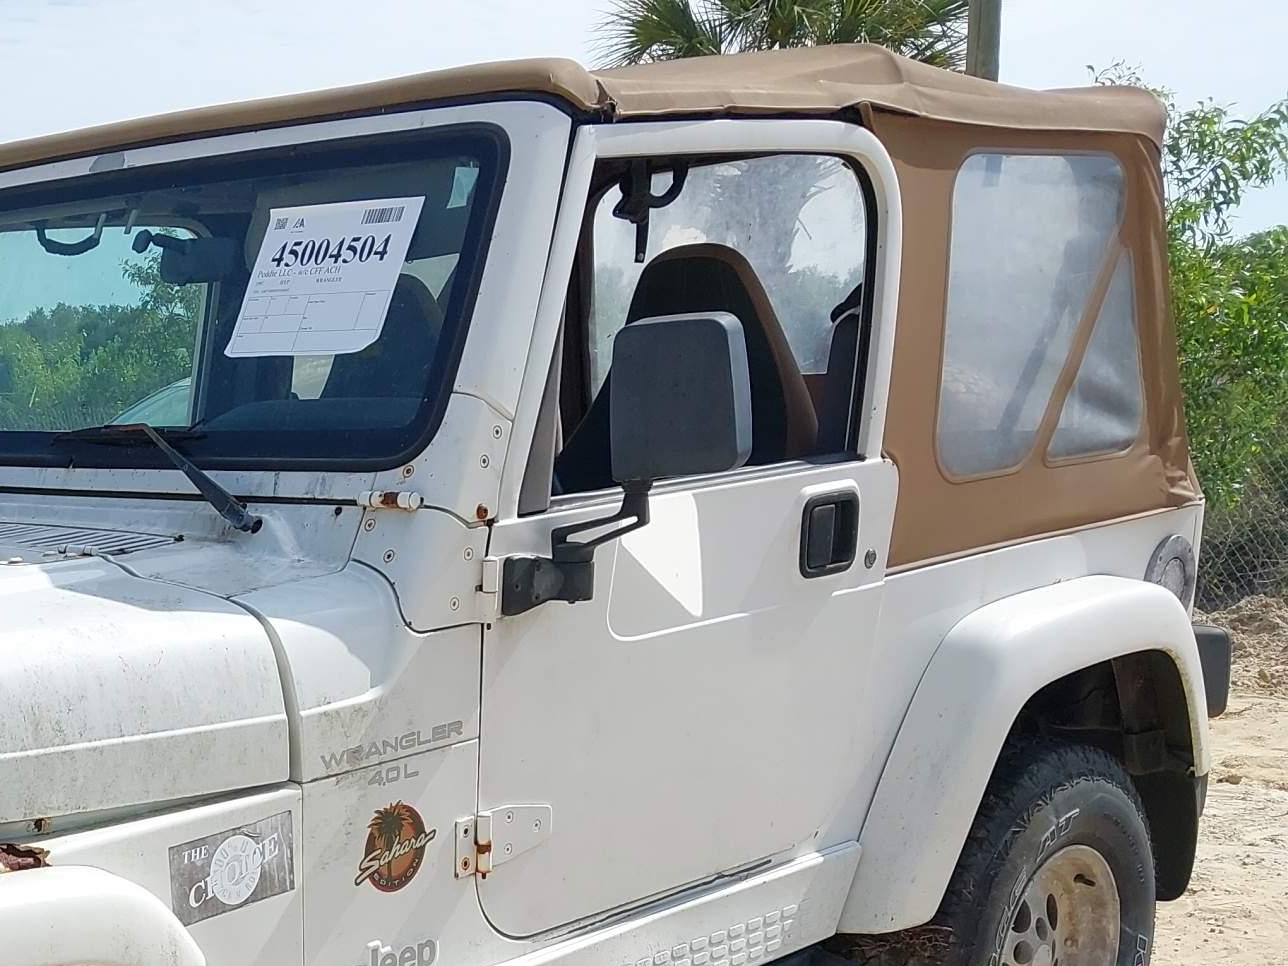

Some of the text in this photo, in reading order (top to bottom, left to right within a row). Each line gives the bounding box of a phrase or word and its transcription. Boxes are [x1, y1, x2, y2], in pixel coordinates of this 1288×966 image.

[271, 234, 392, 267] 45004504
[320, 720, 464, 770] WRANGLER
[182, 845, 209, 865] THE
[1036, 808, 1080, 863] AT
[354, 829, 437, 886] Sahara
[373, 857, 420, 887] EDITION
